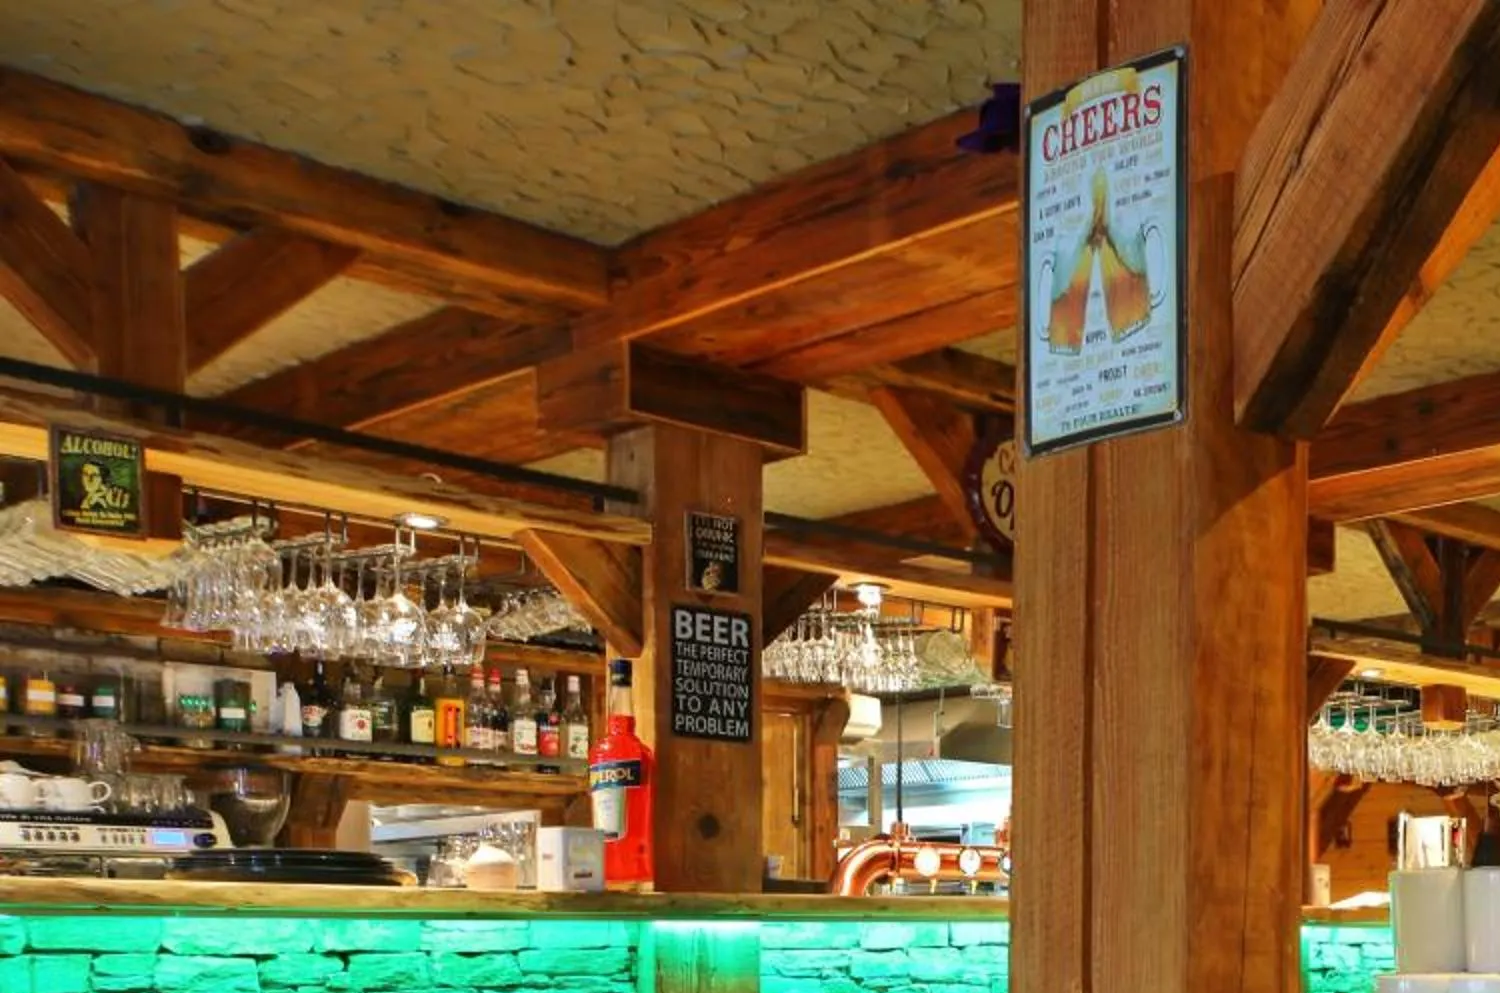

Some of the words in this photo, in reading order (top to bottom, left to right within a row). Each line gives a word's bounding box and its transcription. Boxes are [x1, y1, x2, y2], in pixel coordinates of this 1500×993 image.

[1043, 84, 1161, 162] CHEERS
[674, 609, 749, 648] BEER
[675, 641, 698, 659] THE
[700, 645, 749, 666] PERFECT
[675, 659, 749, 683] TEMPORARY
[675, 677, 749, 699] SOLUTION
[676, 694, 702, 713] TO
[708, 697, 748, 718] ANY
[674, 713, 749, 738] PROBLEM
